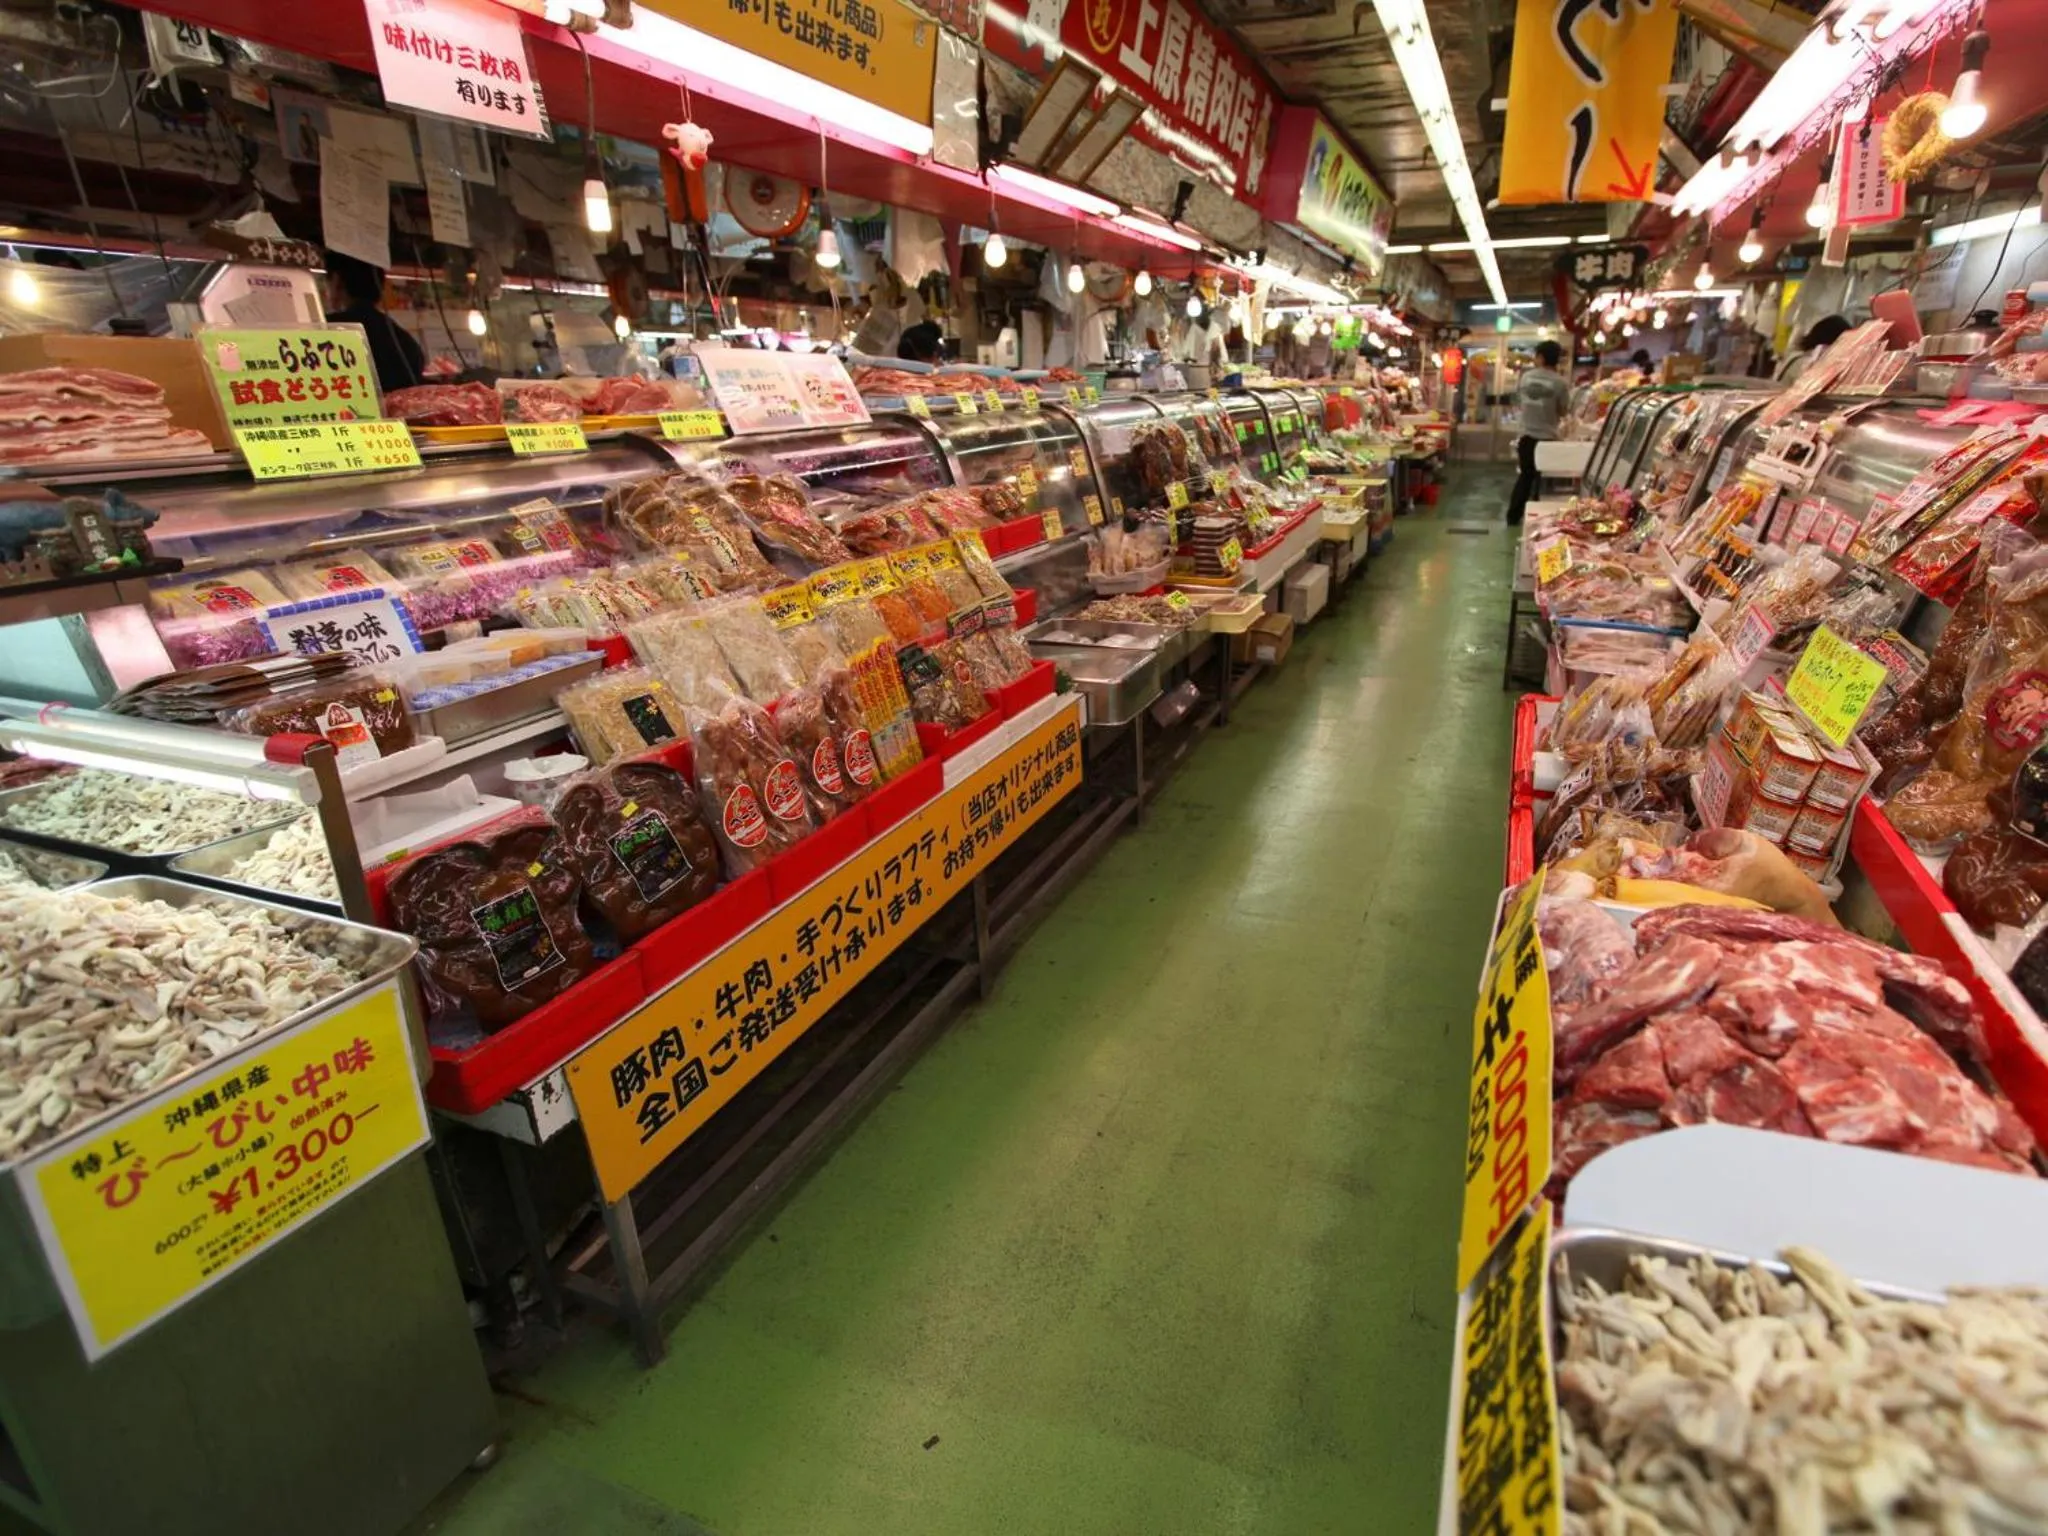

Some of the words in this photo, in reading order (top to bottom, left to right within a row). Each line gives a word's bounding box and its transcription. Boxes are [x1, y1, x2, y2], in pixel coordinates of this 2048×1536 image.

[384, 20, 524, 85] 味付け三枚肉
[455, 77, 526, 116] 有ります
[278, 337, 358, 374] らふてい
[229, 375, 369, 407] 試食どうぞ！
[243, 428, 321, 442] 沖縄県産三枚肉
[359, 424, 394, 436] ¥900
[365, 439, 412, 451] ¥1000
[374, 453, 411, 465] ¥650
[288, 612, 388, 655] 料亭の味
[610, 826, 949, 1108] 豚肉・牛肉・手づくりラフティ
[636, 877, 932, 1144] 全国ご発送受け承ります。
[71, 1138, 137, 1181] 特上
[165, 1064, 273, 1133] 沖縄県産
